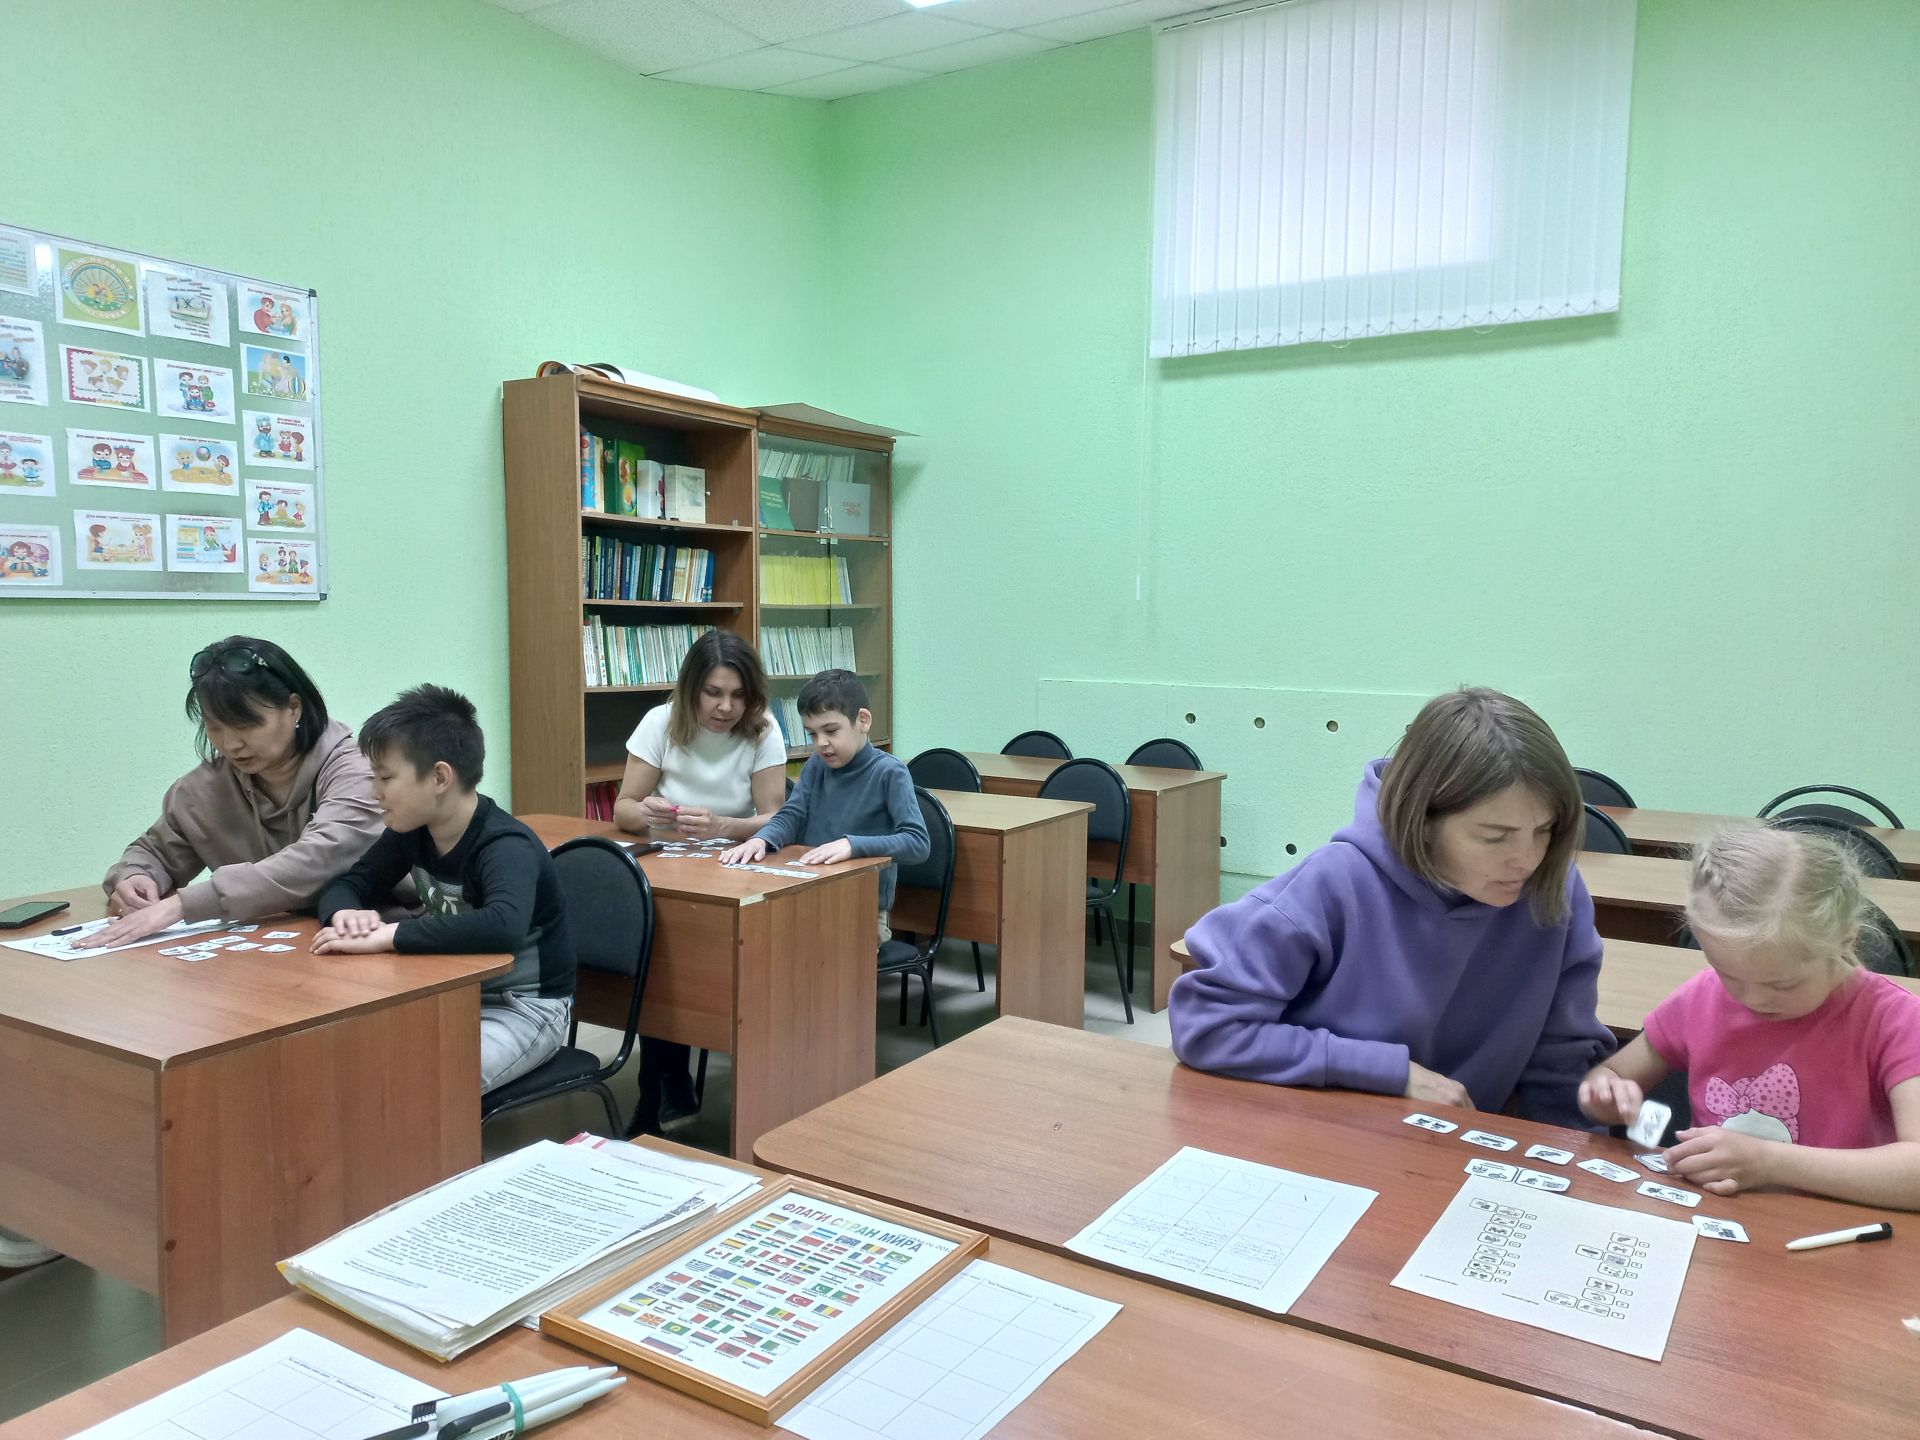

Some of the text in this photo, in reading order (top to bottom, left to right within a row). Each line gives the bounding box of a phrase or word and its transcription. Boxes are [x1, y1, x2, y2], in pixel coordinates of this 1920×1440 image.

[782, 1203, 833, 1223] ФЛАГИ
[830, 1217, 881, 1239] СТРАН
[879, 1232, 923, 1253] МИРА
